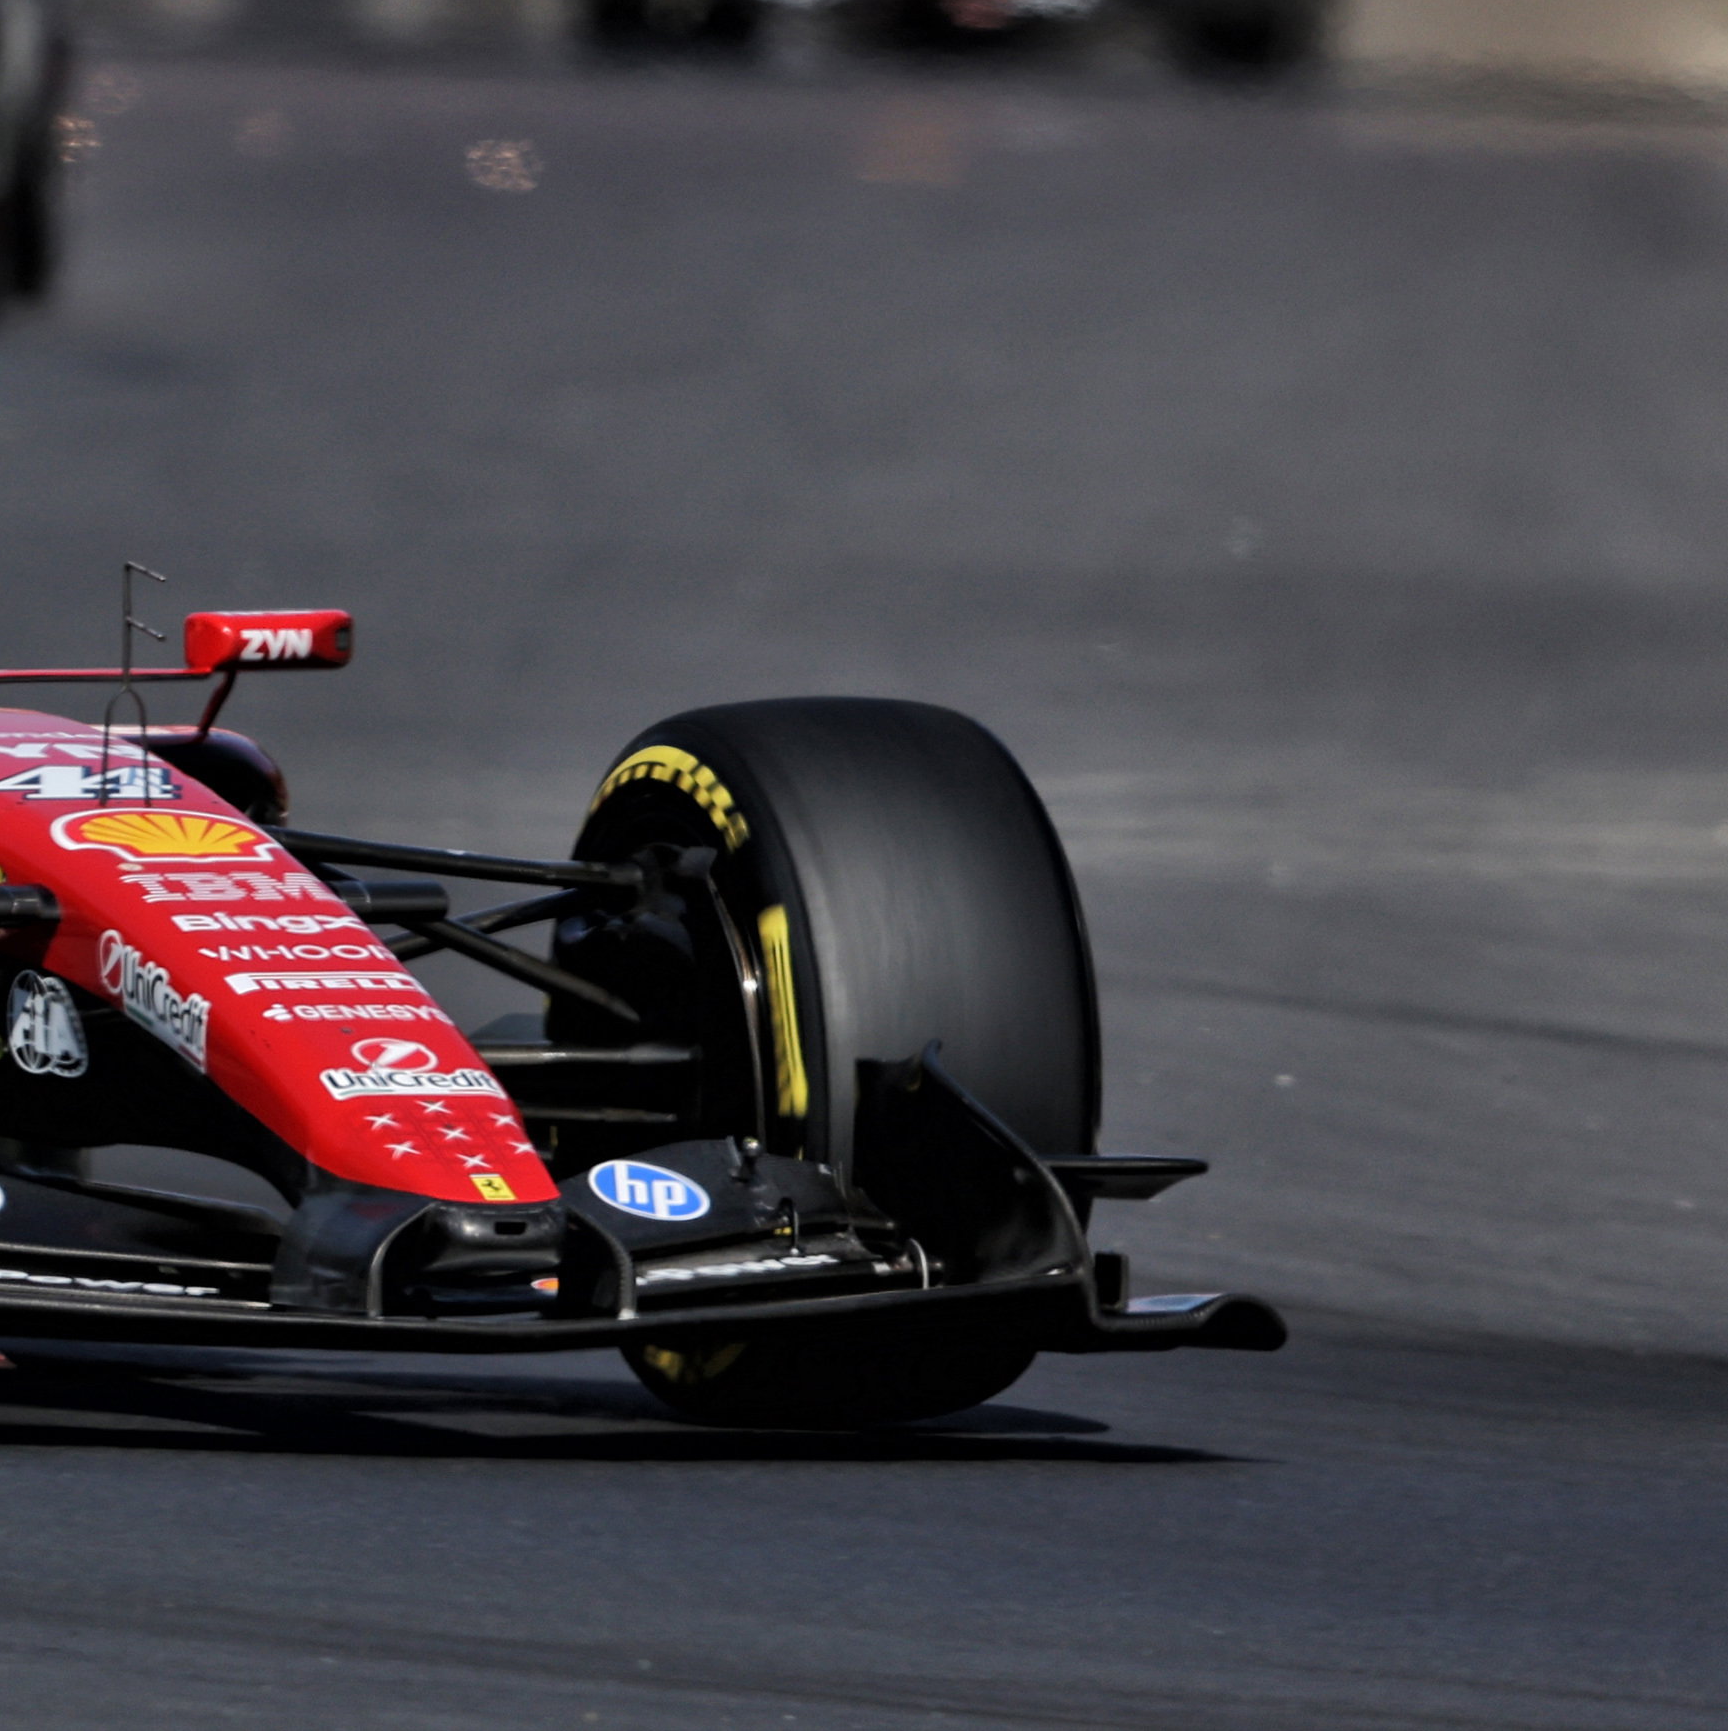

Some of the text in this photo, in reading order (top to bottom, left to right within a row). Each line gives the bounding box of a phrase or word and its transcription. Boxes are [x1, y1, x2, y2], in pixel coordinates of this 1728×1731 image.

[239, 629, 314, 661] ZYN
[120, 871, 347, 903] IBM
[124, 950, 204, 1052] UniCredit
[326, 1070, 501, 1091] UniCredit
[615, 1165, 687, 1219] hp
